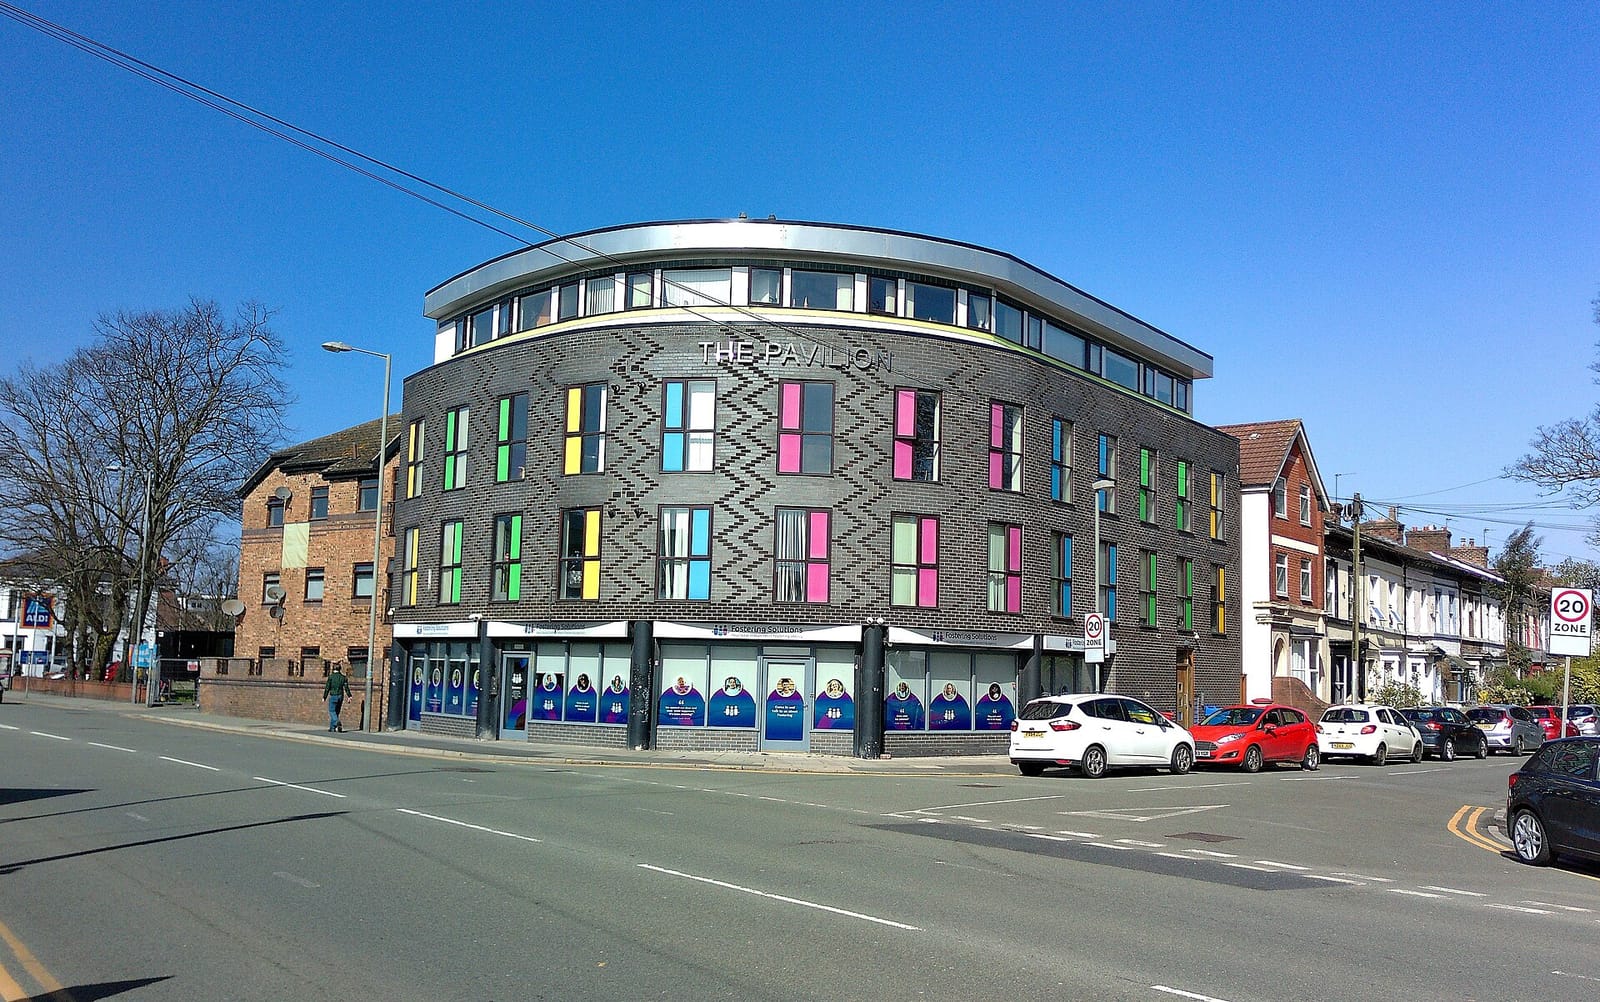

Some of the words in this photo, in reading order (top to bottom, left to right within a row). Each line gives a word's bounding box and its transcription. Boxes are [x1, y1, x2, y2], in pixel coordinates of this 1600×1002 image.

[698, 341, 753, 366] THE
[764, 342, 894, 373] PAVILION
[1560, 599, 1584, 613] 20
[731, 624, 766, 634] Fostering
[767, 625, 803, 633] Solutions
[1088, 621, 1100, 631] 20
[1554, 623, 1587, 633] ZONE
[945, 631, 971, 640] Fostering
[972, 632, 998, 641] Solutions
